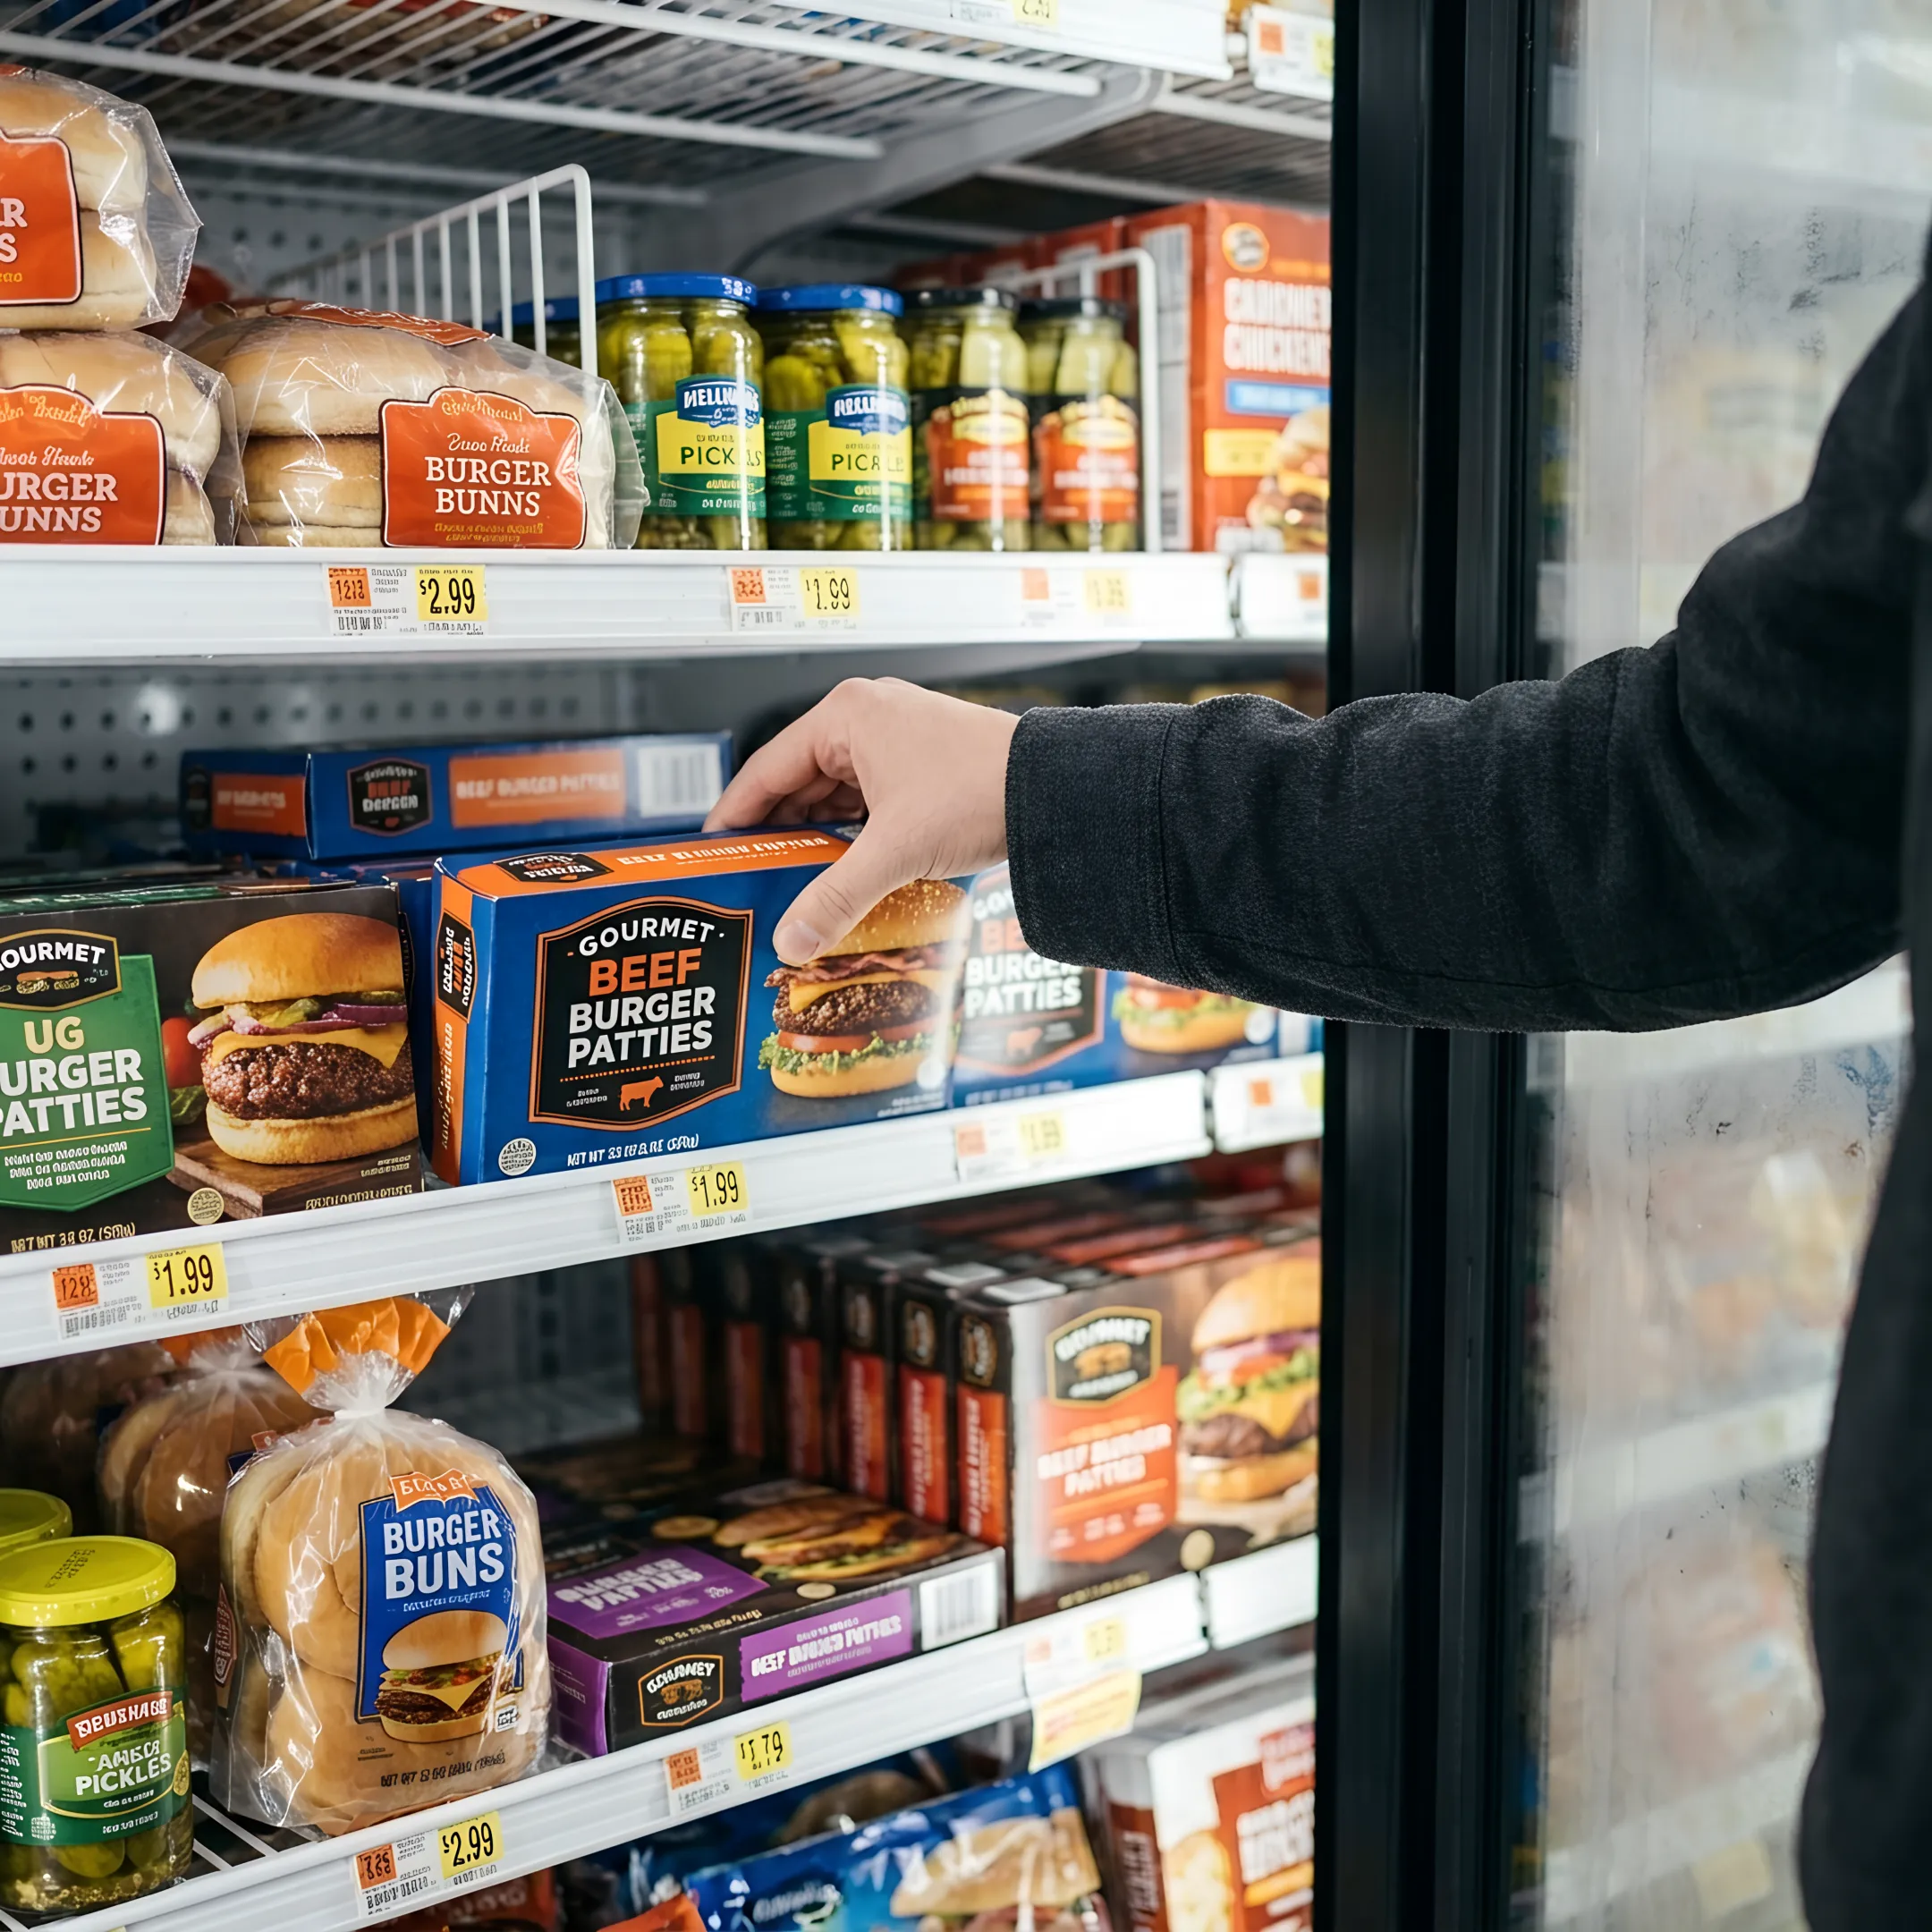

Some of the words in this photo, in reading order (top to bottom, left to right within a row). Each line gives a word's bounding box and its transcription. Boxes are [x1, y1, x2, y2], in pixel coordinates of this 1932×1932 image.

[424, 456, 552, 487] BURGER
[435, 488, 541, 517] BUNNS
[419, 577, 476, 614] $2.99
[579, 917, 716, 957] GOURMET
[589, 947, 703, 997] BEEF
[569, 986, 716, 1035] BURGER
[964, 976, 1083, 1019] PATTIES
[23, 1016, 85, 1055] UG
[568, 1020, 714, 1069] PATTIES
[0, 1086, 148, 1138] ATTIES
[691, 1170, 739, 1208] $1.99
[383, 1508, 502, 1555] BURGER
[385, 1542, 504, 1600] BUNS
[75, 1752, 173, 1796] PICKLES
